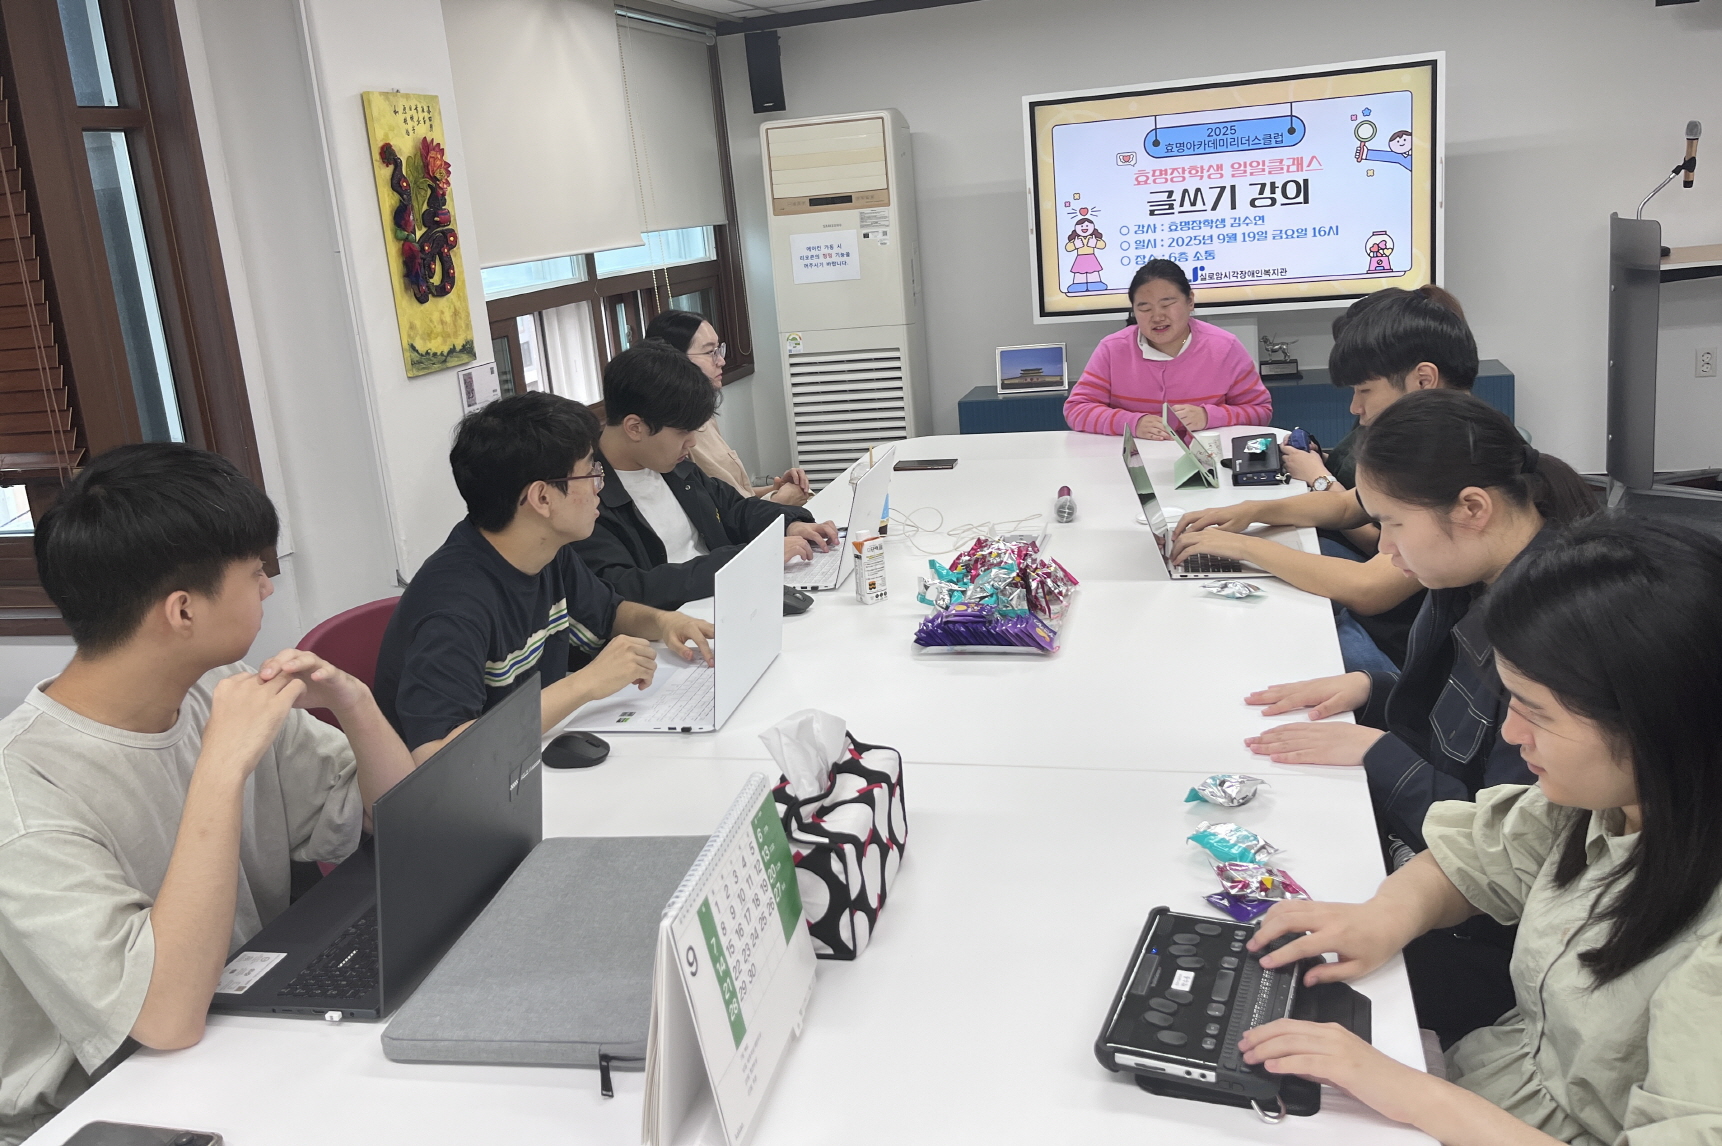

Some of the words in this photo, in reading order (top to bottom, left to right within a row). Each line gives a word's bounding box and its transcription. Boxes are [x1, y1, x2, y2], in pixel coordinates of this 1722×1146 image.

[1164, 132, 1284, 154] 효명아카데미리더스클럽
[1206, 125, 1237, 138] 2025
[1133, 163, 1224, 186] 효명장학생
[1230, 155, 1324, 178] 일일클래스
[1147, 184, 1238, 217] 글쓰기
[1249, 178, 1310, 209] 강의
[1134, 222, 1157, 235] 강사
[1168, 217, 1226, 233] 효명장학생
[1230, 214, 1266, 228] 김수연
[1134, 238, 1157, 250] 일시
[1168, 234, 1214, 249] 2025년
[1217, 232, 1238, 244] 9월
[1241, 230, 1268, 242] 19일
[1272, 227, 1308, 241] 금요일
[1312, 224, 1340, 238] 16시
[1168, 252, 1189, 263] 6층
[1192, 250, 1216, 262] 소통
[1200, 268, 1288, 282] 실로암시각장애인복지관
[714, 900, 720, 914] 1
[724, 884, 730, 900] 2
[732, 870, 738, 884] 3
[742, 855, 747, 868] 4
[748, 841, 755, 856] 5
[757, 828, 763, 843] 6
[710, 936, 718, 956] 7
[720, 921, 727, 936] 8
[730, 904, 736, 920] 9
[737, 888, 746, 906] 10
[746, 874, 754, 890] 11
[754, 859, 762, 876] 12
[761, 846, 770, 862] 13
[716, 956, 726, 976] 14
[726, 938, 735, 958] 15
[735, 923, 744, 941] 16
[744, 907, 752, 926] 17
[752, 893, 760, 910] 18
[760, 878, 768, 896] 19
[768, 864, 776, 883] 20
[722, 976, 732, 1000] 21
[732, 959, 742, 981] 22
[742, 942, 751, 964] 23
[750, 926, 760, 948] 24
[758, 911, 768, 932] 25
[766, 896, 775, 917] 26
[773, 882, 782, 902] 27
[686, 944, 699, 977] 9
[729, 998, 738, 1022] 28
[738, 980, 747, 1002] 29
[748, 962, 756, 984] 30
